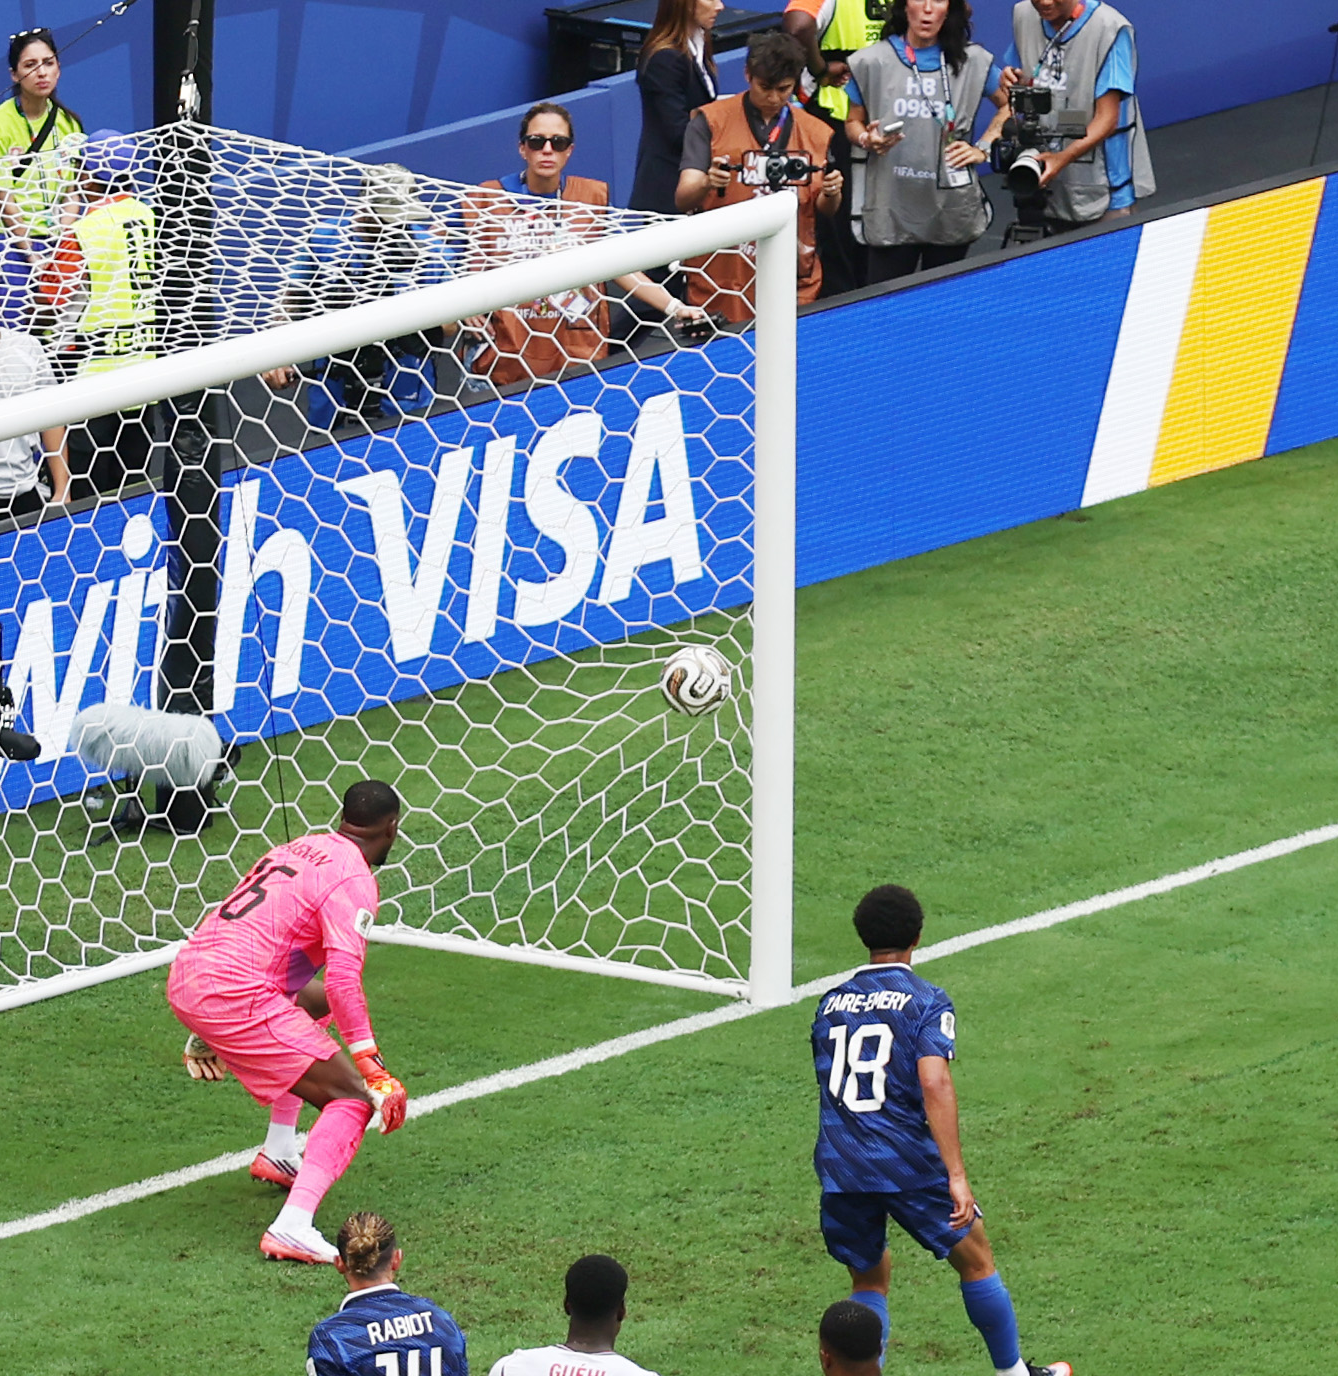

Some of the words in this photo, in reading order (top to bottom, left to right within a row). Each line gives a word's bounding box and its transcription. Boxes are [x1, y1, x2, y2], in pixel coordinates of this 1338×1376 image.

[906, 76, 937, 96] HB
[335, 391, 704, 664] VISA
[823, 990, 913, 1016] ZAIRE-EMERY
[828, 1023, 895, 1113] 18
[366, 1311, 434, 1345] RABIOT
